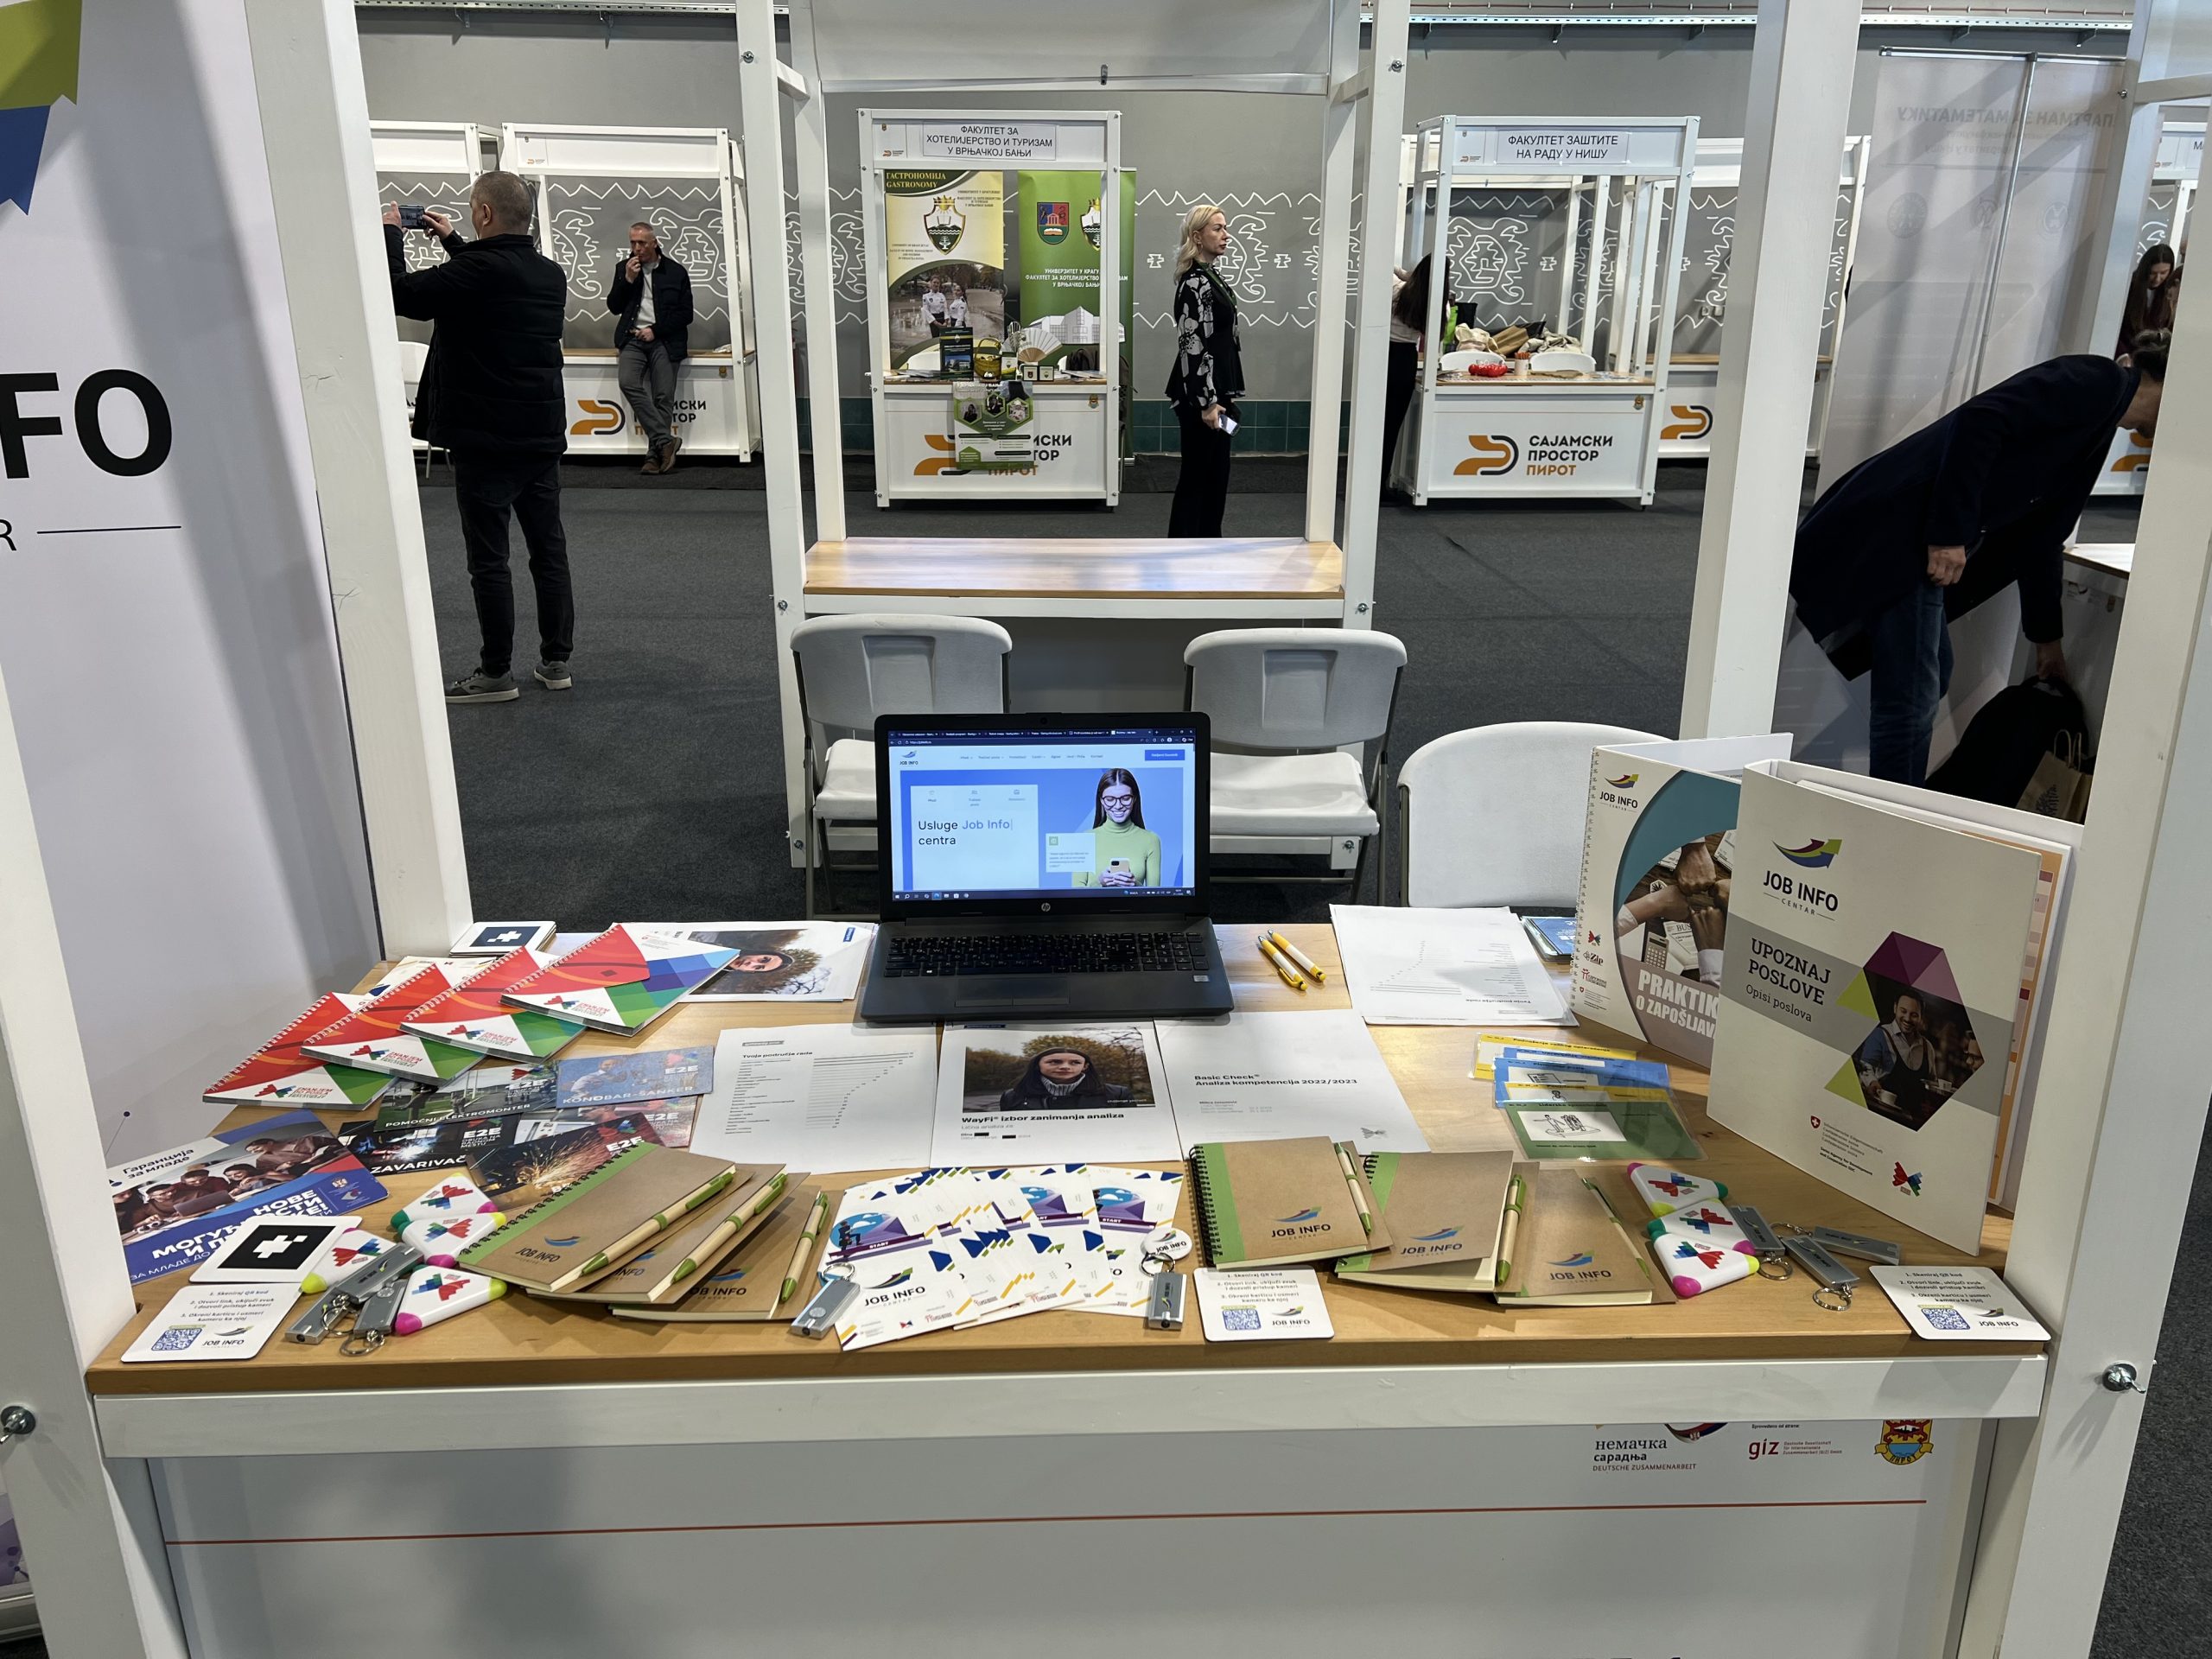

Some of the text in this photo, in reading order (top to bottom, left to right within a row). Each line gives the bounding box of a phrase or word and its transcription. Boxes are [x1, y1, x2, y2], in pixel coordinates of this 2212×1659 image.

[961, 125, 1019, 136] ФАКУЛТЕТ ЗА
[926, 135, 1052, 147] ХОТЕЛИЈЕРСТВО И ТУРИЗАМ
[1508, 135, 1618, 145] ФАКУЛТЕТ ЗАШТИТЕ
[956, 147, 1003, 157] ВРЊАЧКОЈ
[1005, 149, 1032, 157] БАЊИ
[1516, 149, 1608, 160] НА РАДУ У НИШУ
[1529, 435, 1613, 447] САЈАМСКИ
[1528, 449, 1599, 461] ПРОСТОР
[1526, 465, 1577, 476] ПИРОТ
[1599, 791, 1638, 809] JOB INFO
[918, 819, 1010, 832] Usluge Job Info
[918, 836, 957, 845] centra
[1764, 870, 1839, 912] JOB INFO
[1782, 898, 1815, 915] CENTAR
[1751, 938, 1831, 984] UPOZNAJ
[1748, 958, 1825, 1006] POSLOVE
[1636, 995, 1645, 1011] O
[1745, 984, 1812, 1022] Opisi poslova
[664, 1065, 699, 1075] E2E
[439, 1103, 531, 1122] ELEKTROMONTER
[463, 1127, 501, 1139] E2E
[123, 1149, 194, 1175] Гаранција
[127, 1156, 190, 1179] за младе
[370, 1154, 467, 1174] ZAVARIVAČ
[253, 1189, 317, 1216] НОВЕ
[1271, 1224, 1332, 1238] JOB INFO
[869, 1241, 889, 1249] START
[1156, 1240, 1187, 1254] JOB INFO
[1401, 1243, 1463, 1255] JOB INFO
[515, 1248, 561, 1263] JOB INFO
[130, 1271, 147, 1281] ЗА
[149, 1257, 191, 1276] МЛАДЕ
[1548, 1269, 1611, 1281] JOB INFO
[714, 1287, 747, 1295] INFO
[865, 1286, 925, 1306] JOB INFO
[1595, 1439, 1668, 1451] немачка
[1748, 1438, 1780, 1460] giz
[1593, 1453, 1647, 1465] сарадња
